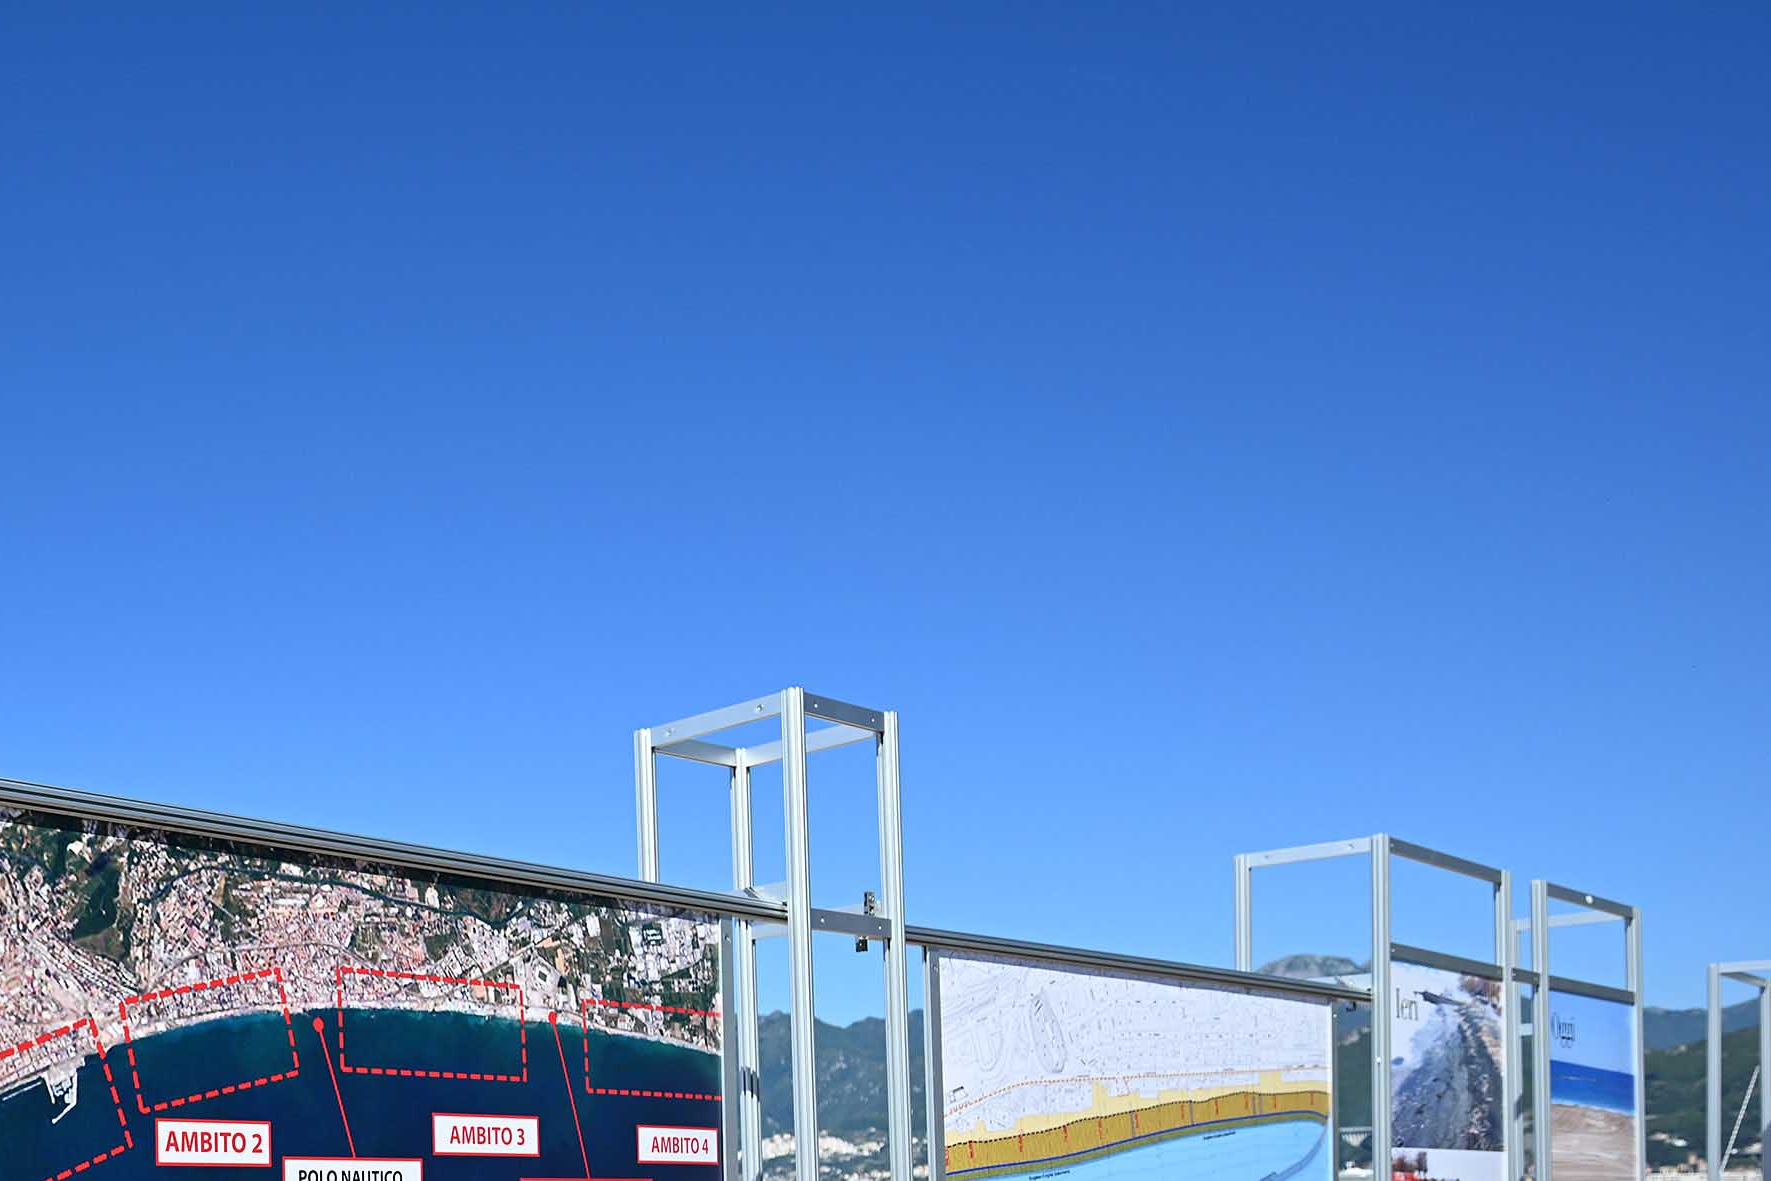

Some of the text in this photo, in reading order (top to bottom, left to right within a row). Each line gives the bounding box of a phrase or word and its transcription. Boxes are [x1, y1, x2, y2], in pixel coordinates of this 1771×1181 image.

[165, 1130, 263, 1153] AMBITO 2
[449, 1125, 526, 1146] AMBITO 3
[651, 1136, 710, 1154] AMBITO 4
